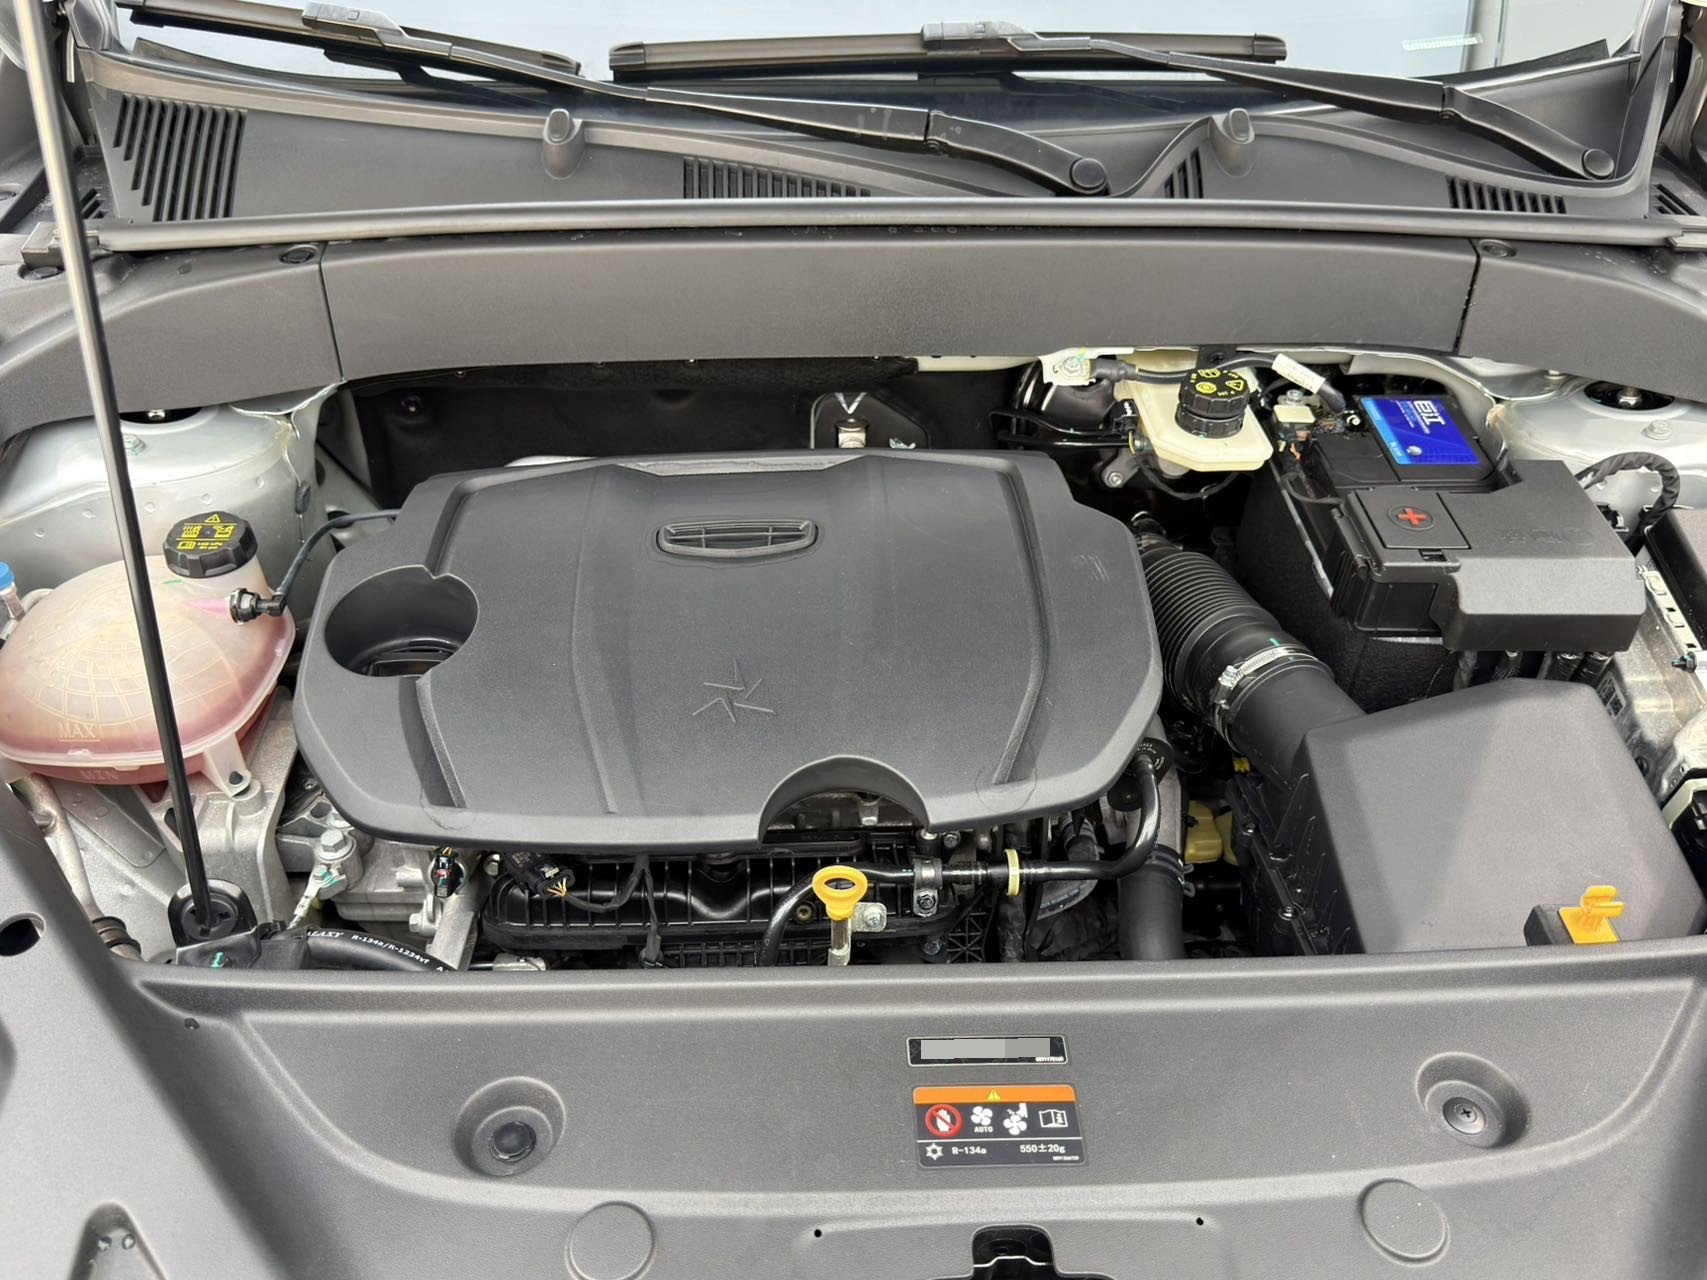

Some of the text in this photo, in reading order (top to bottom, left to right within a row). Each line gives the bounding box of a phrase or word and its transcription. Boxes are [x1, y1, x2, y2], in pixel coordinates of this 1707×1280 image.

[58, 722, 97, 739] MAX
[951, 1144, 1066, 1155] R-134a 550±20g
